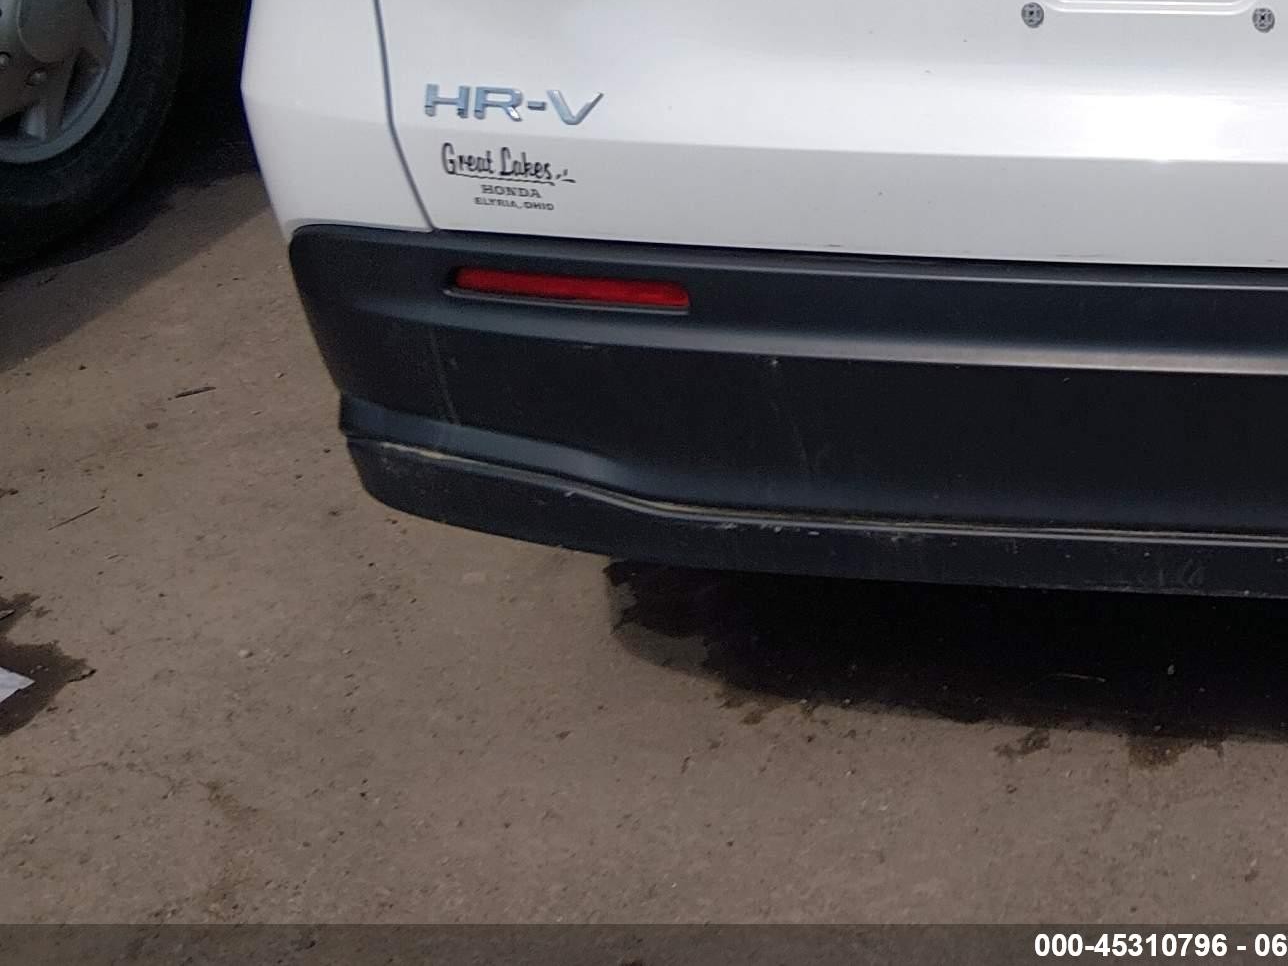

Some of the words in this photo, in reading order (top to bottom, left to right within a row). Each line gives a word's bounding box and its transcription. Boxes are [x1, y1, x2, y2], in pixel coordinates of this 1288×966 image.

[424, 83, 604, 126] HR-V
[441, 141, 494, 175] Great
[498, 146, 553, 181] Lakes
[479, 184, 542, 200] HONDA
